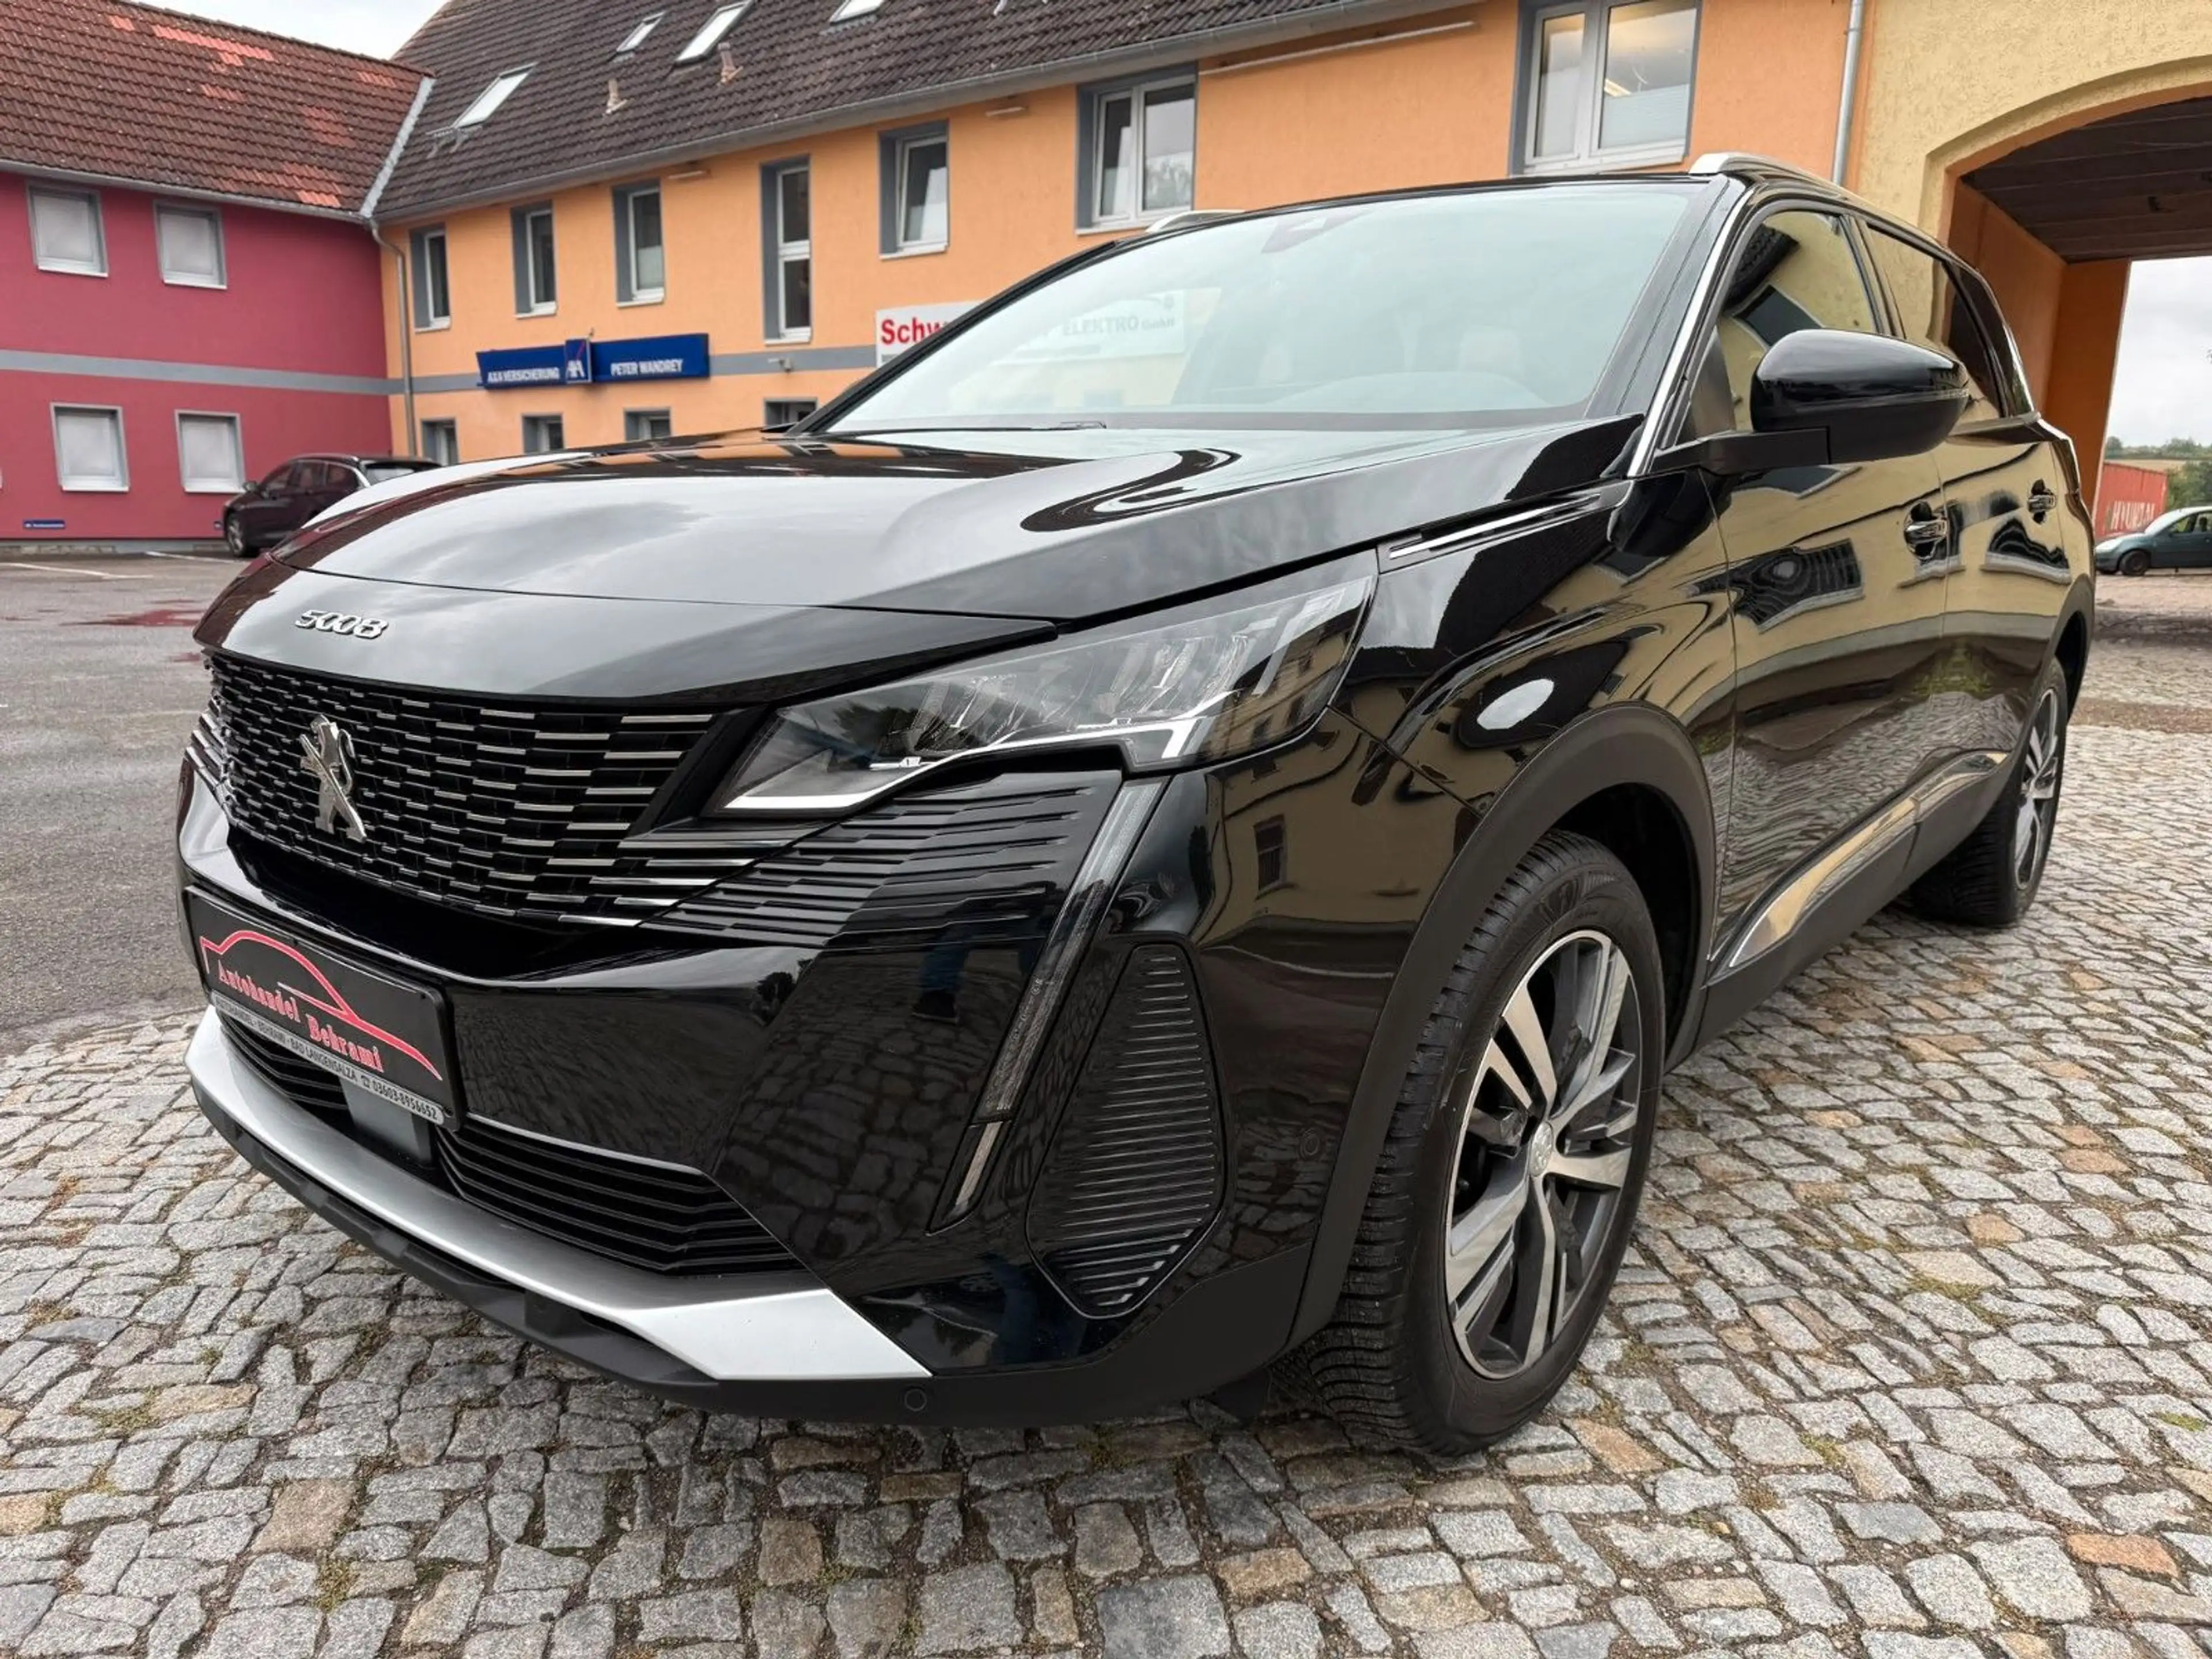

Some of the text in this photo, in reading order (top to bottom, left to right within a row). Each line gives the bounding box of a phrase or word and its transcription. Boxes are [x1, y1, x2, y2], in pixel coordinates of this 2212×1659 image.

[1063, 315, 1139, 335] ELEKTRO
[504, 367, 560, 382] VERSICHERUNG
[611, 362, 638, 376] PETER
[294, 609, 389, 639] 5008
[218, 959, 301, 1022] Autohandel
[305, 1013, 384, 1073] Behrami
[290, 1036, 305, 1055] BAD
[305, 1044, 357, 1083] LANGENSALZA
